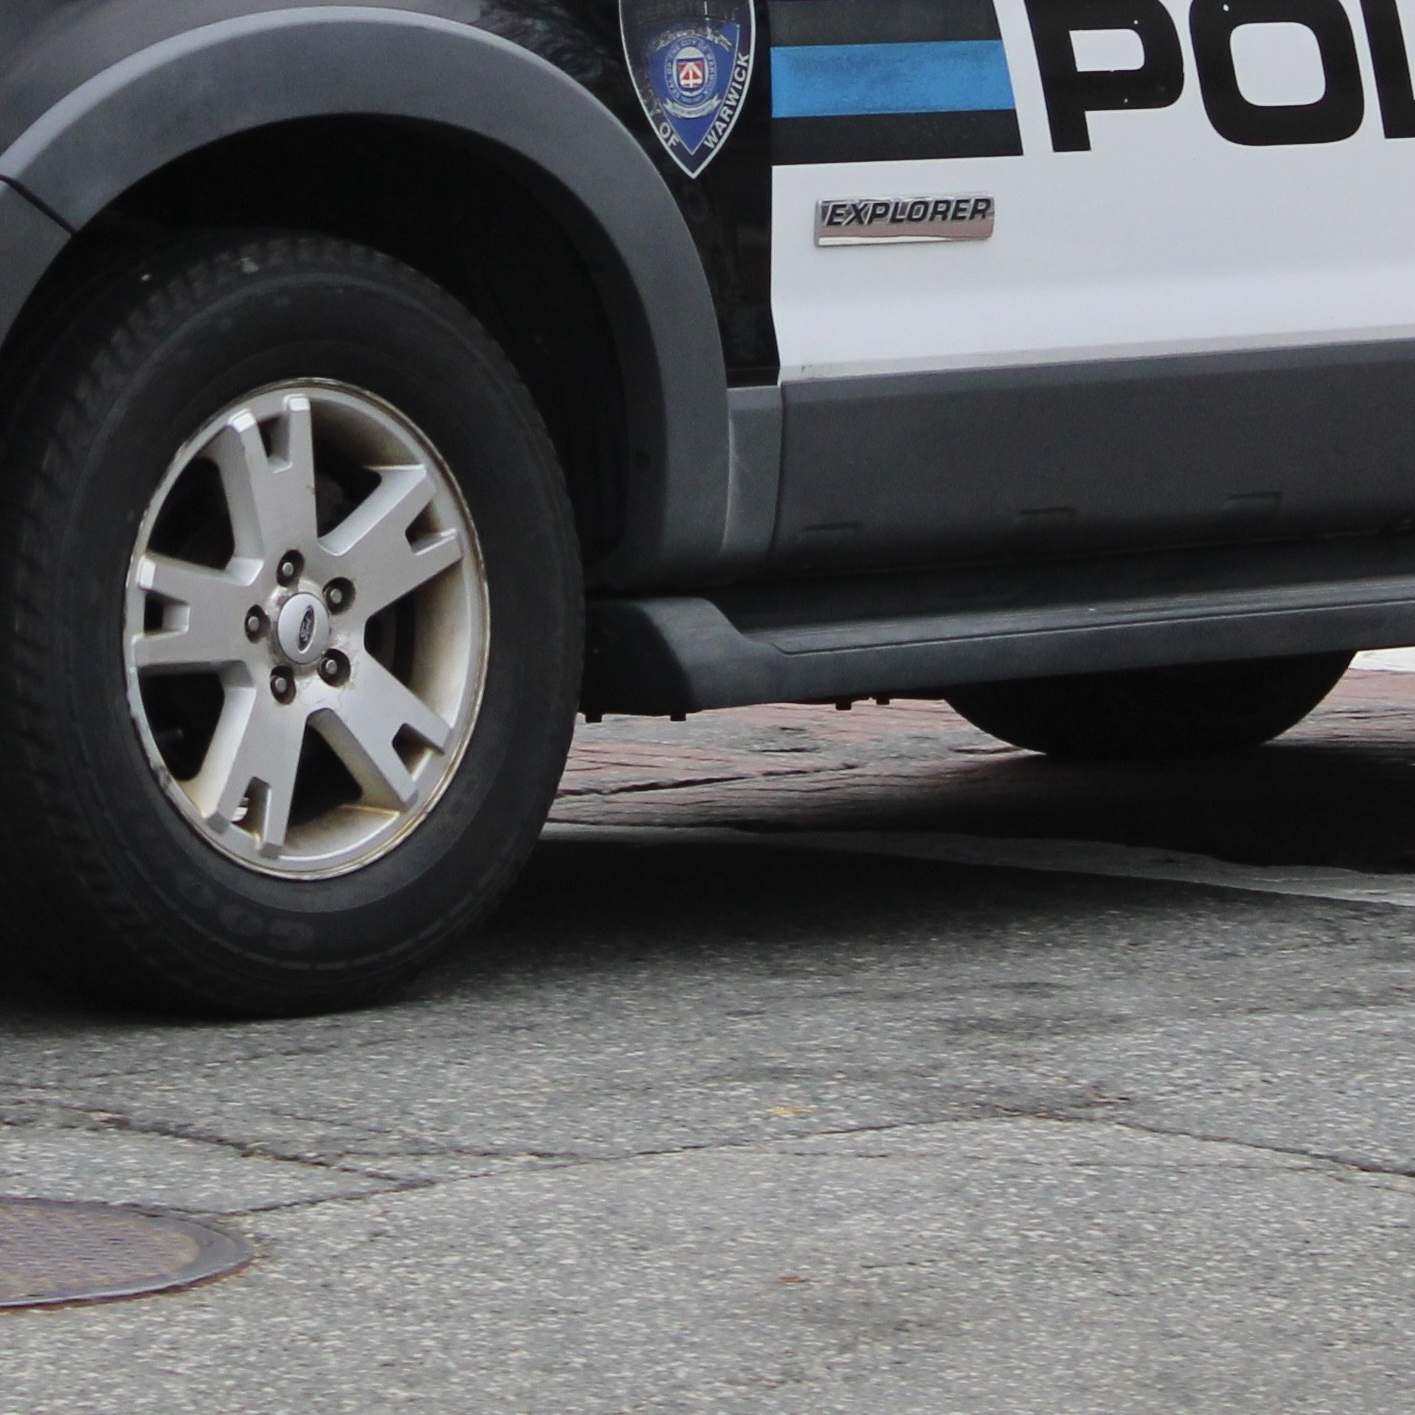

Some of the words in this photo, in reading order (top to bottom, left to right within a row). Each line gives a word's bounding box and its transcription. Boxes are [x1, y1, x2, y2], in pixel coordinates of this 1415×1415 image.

[659, 121, 680, 148] OF
[703, 52, 750, 150] WARWICK
[826, 198, 992, 226] EXPLORER
